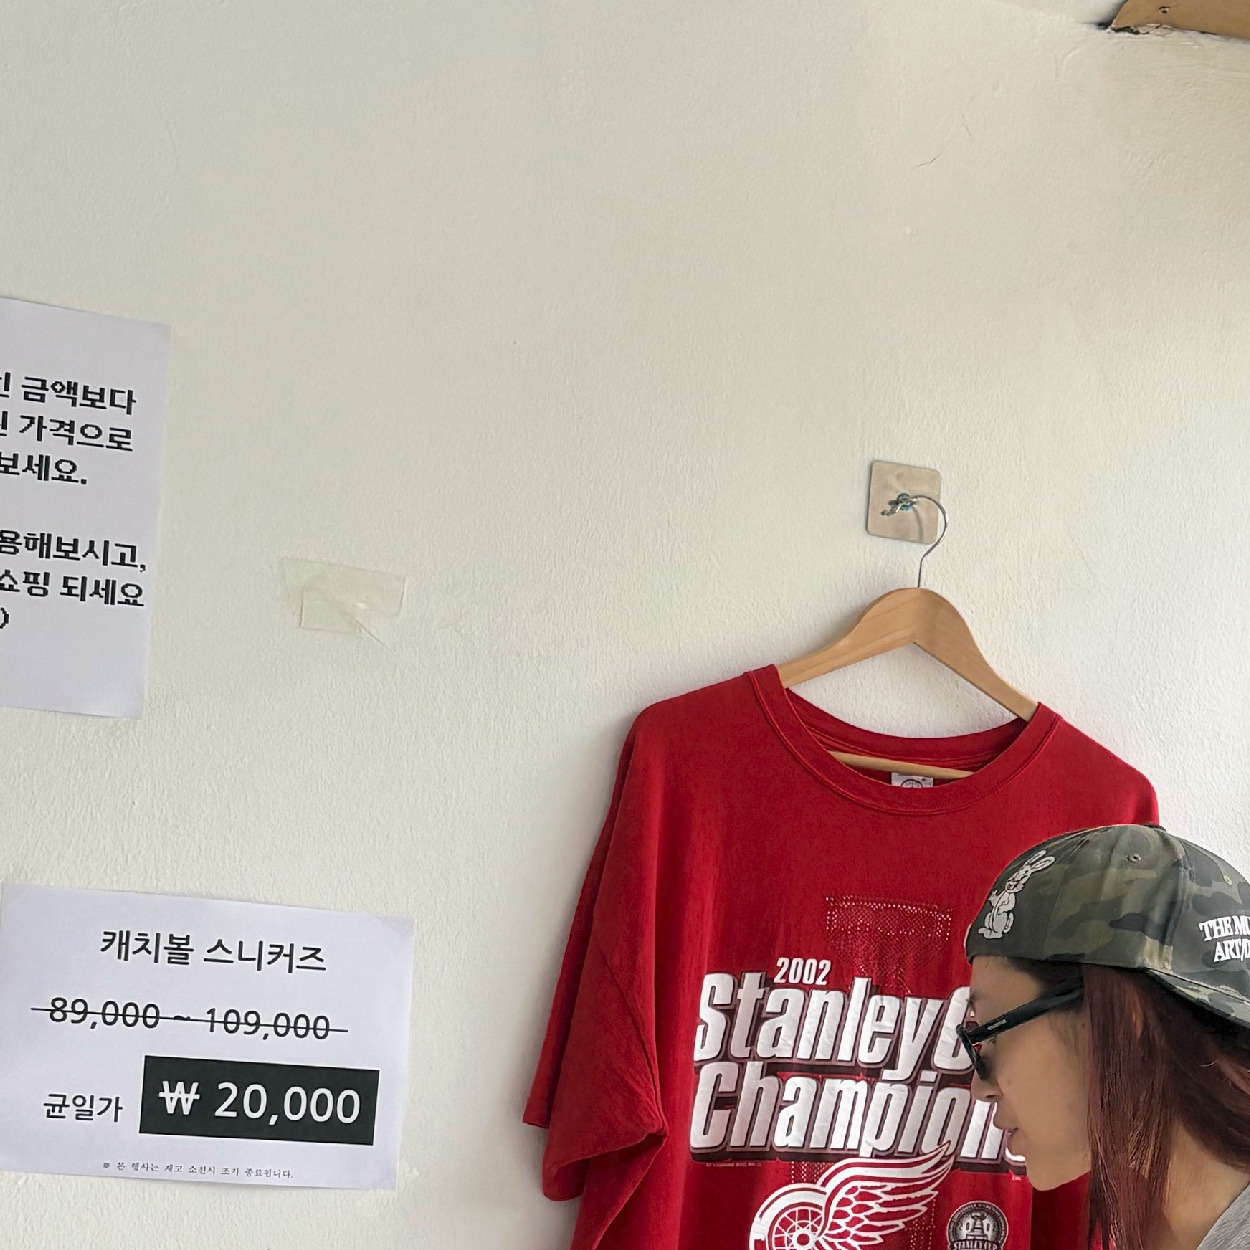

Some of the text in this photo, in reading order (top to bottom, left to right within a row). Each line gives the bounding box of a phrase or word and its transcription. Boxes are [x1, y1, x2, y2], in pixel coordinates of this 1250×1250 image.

[21, 376, 137, 415] 금액보다
[19, 415, 133, 452] 가격으로
[60, 576, 145, 606] 되세요
[1199, 916, 1233, 941] THE
[100, 930, 327, 973] 캐치볼 스니커즈
[773, 957, 831, 986] 2002
[49, 997, 160, 1030] 89,000
[206, 1008, 330, 1041] 109,000
[693, 972, 944, 1081] Stanley
[43, 1080, 360, 1126] 균일가 ₩ 20,000
[689, 1061, 1027, 1158] Champion
